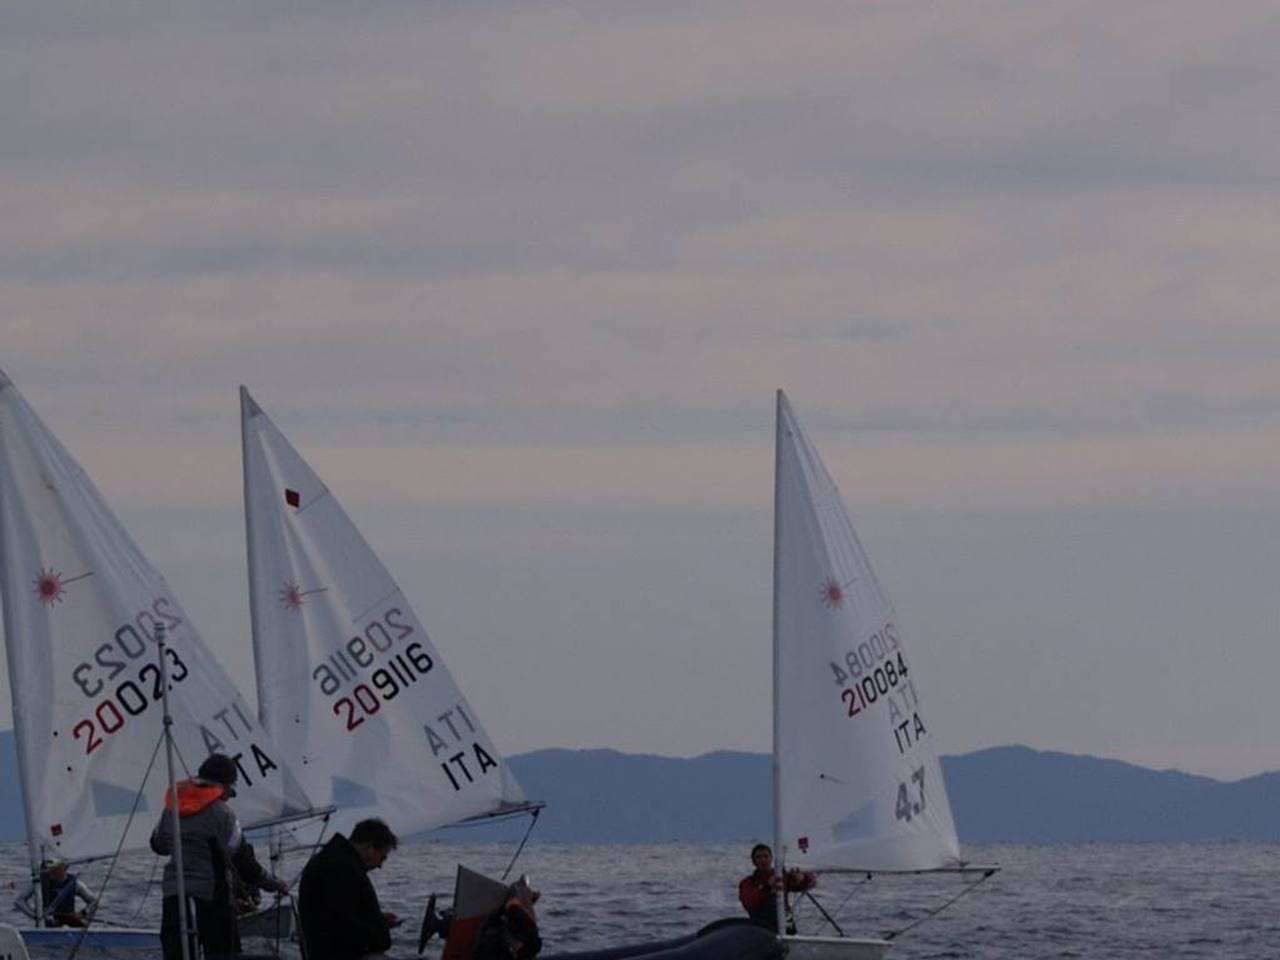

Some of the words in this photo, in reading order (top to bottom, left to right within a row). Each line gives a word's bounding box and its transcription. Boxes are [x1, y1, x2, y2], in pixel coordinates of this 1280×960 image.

[332, 642, 434, 732] 209116
[840, 652, 908, 717] 210084
[893, 712, 926, 754] ITA
[231, 743, 278, 787] TA
[440, 742, 498, 791] ITA
